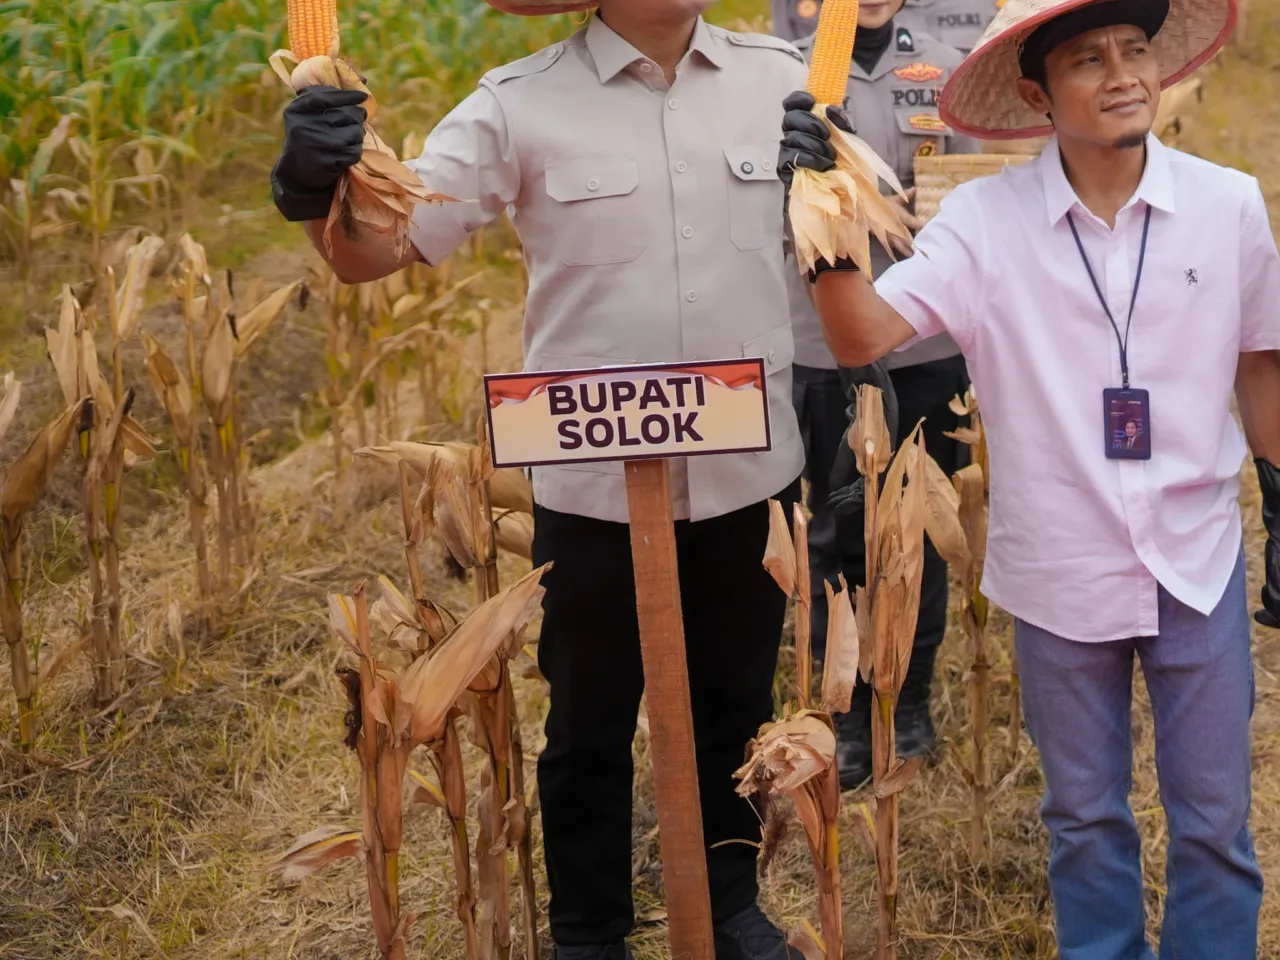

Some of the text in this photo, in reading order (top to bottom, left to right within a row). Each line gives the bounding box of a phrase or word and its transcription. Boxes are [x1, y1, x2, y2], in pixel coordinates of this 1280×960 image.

[938, 12, 981, 26] POLRI
[892, 88, 941, 105] POLR
[548, 376, 706, 415] BUPATI
[557, 412, 704, 450] SOLOK
